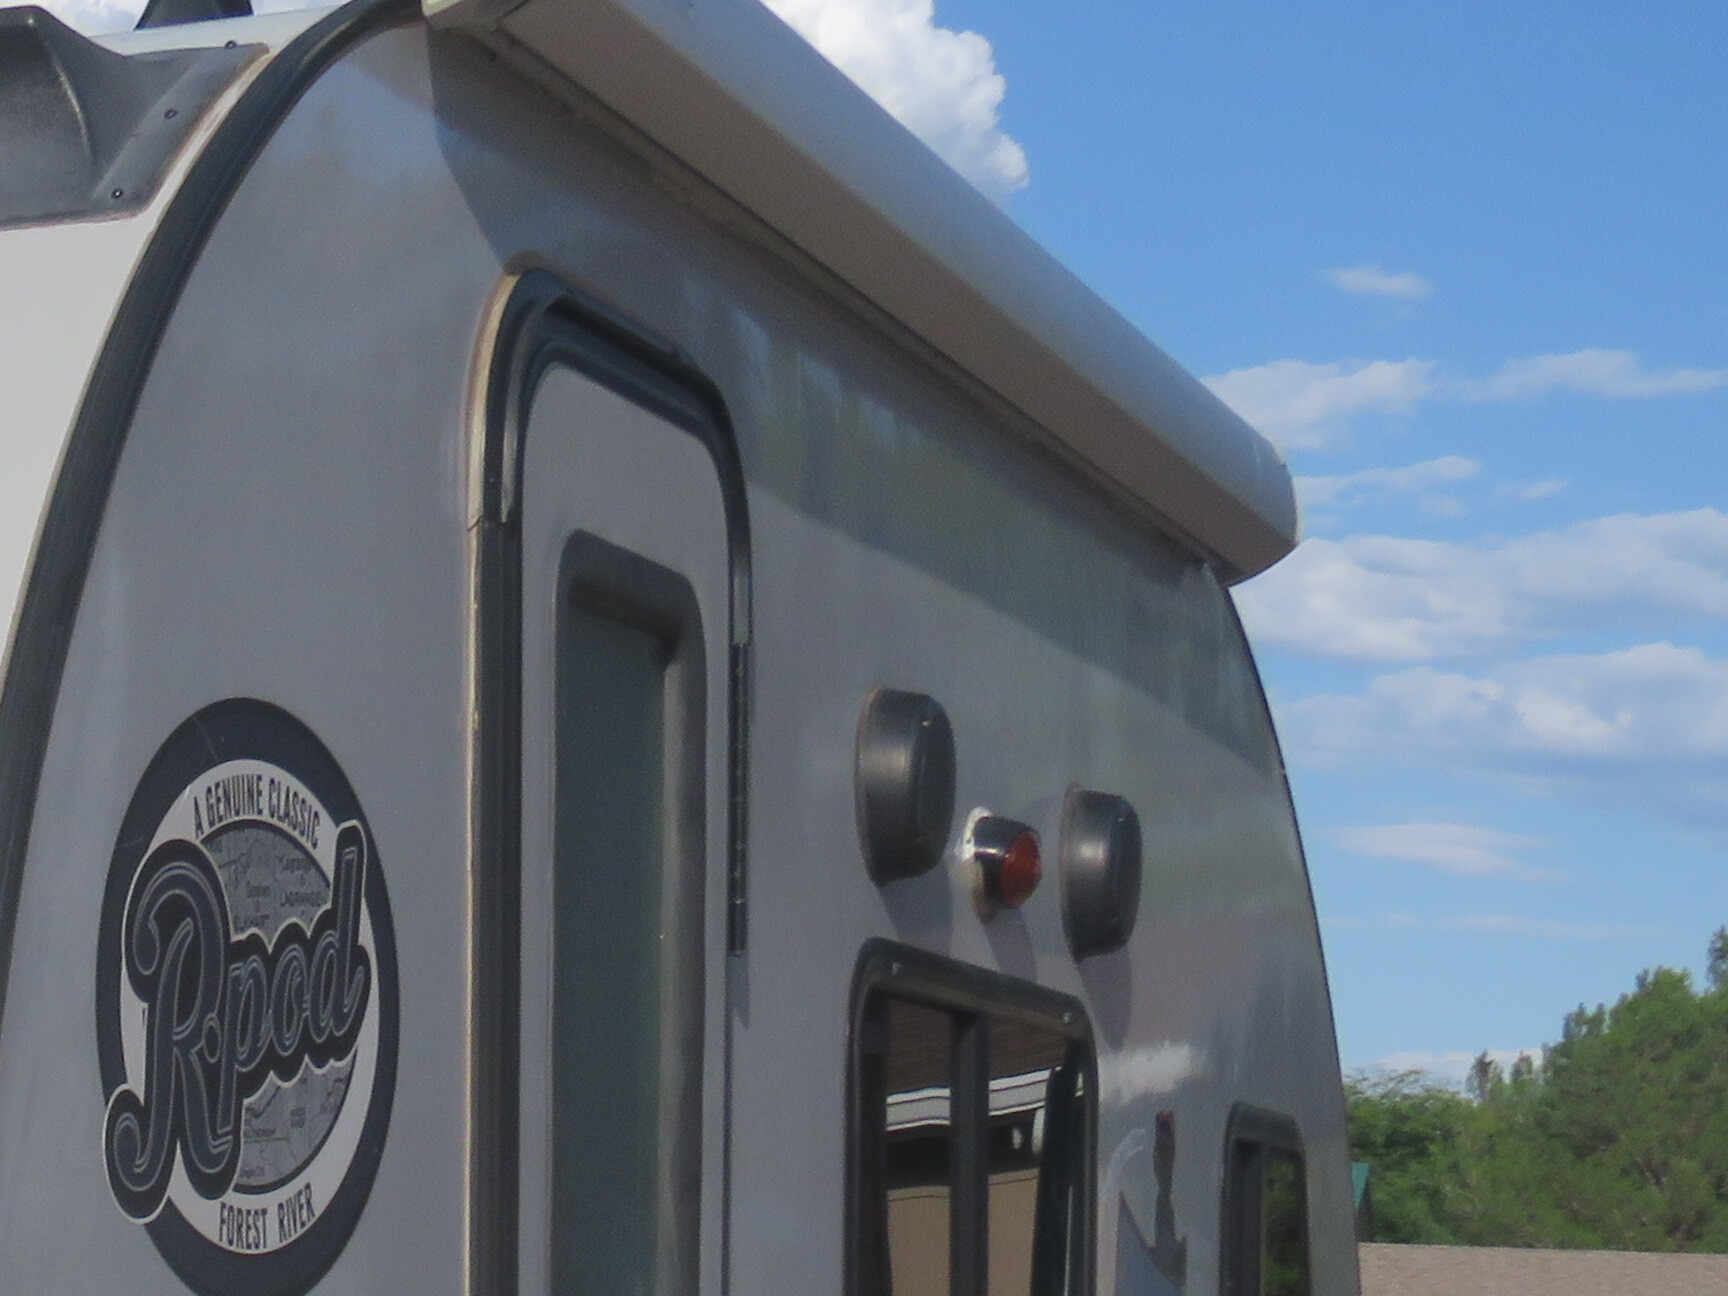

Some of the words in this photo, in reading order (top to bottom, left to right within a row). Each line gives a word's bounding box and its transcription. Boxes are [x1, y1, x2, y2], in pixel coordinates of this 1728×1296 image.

[194, 796, 204, 838] A
[205, 774, 263, 828] GENUINE
[268, 777, 320, 849] CLASSIC
[219, 1201, 268, 1249] FOREST
[277, 1182, 316, 1243] RIVER
